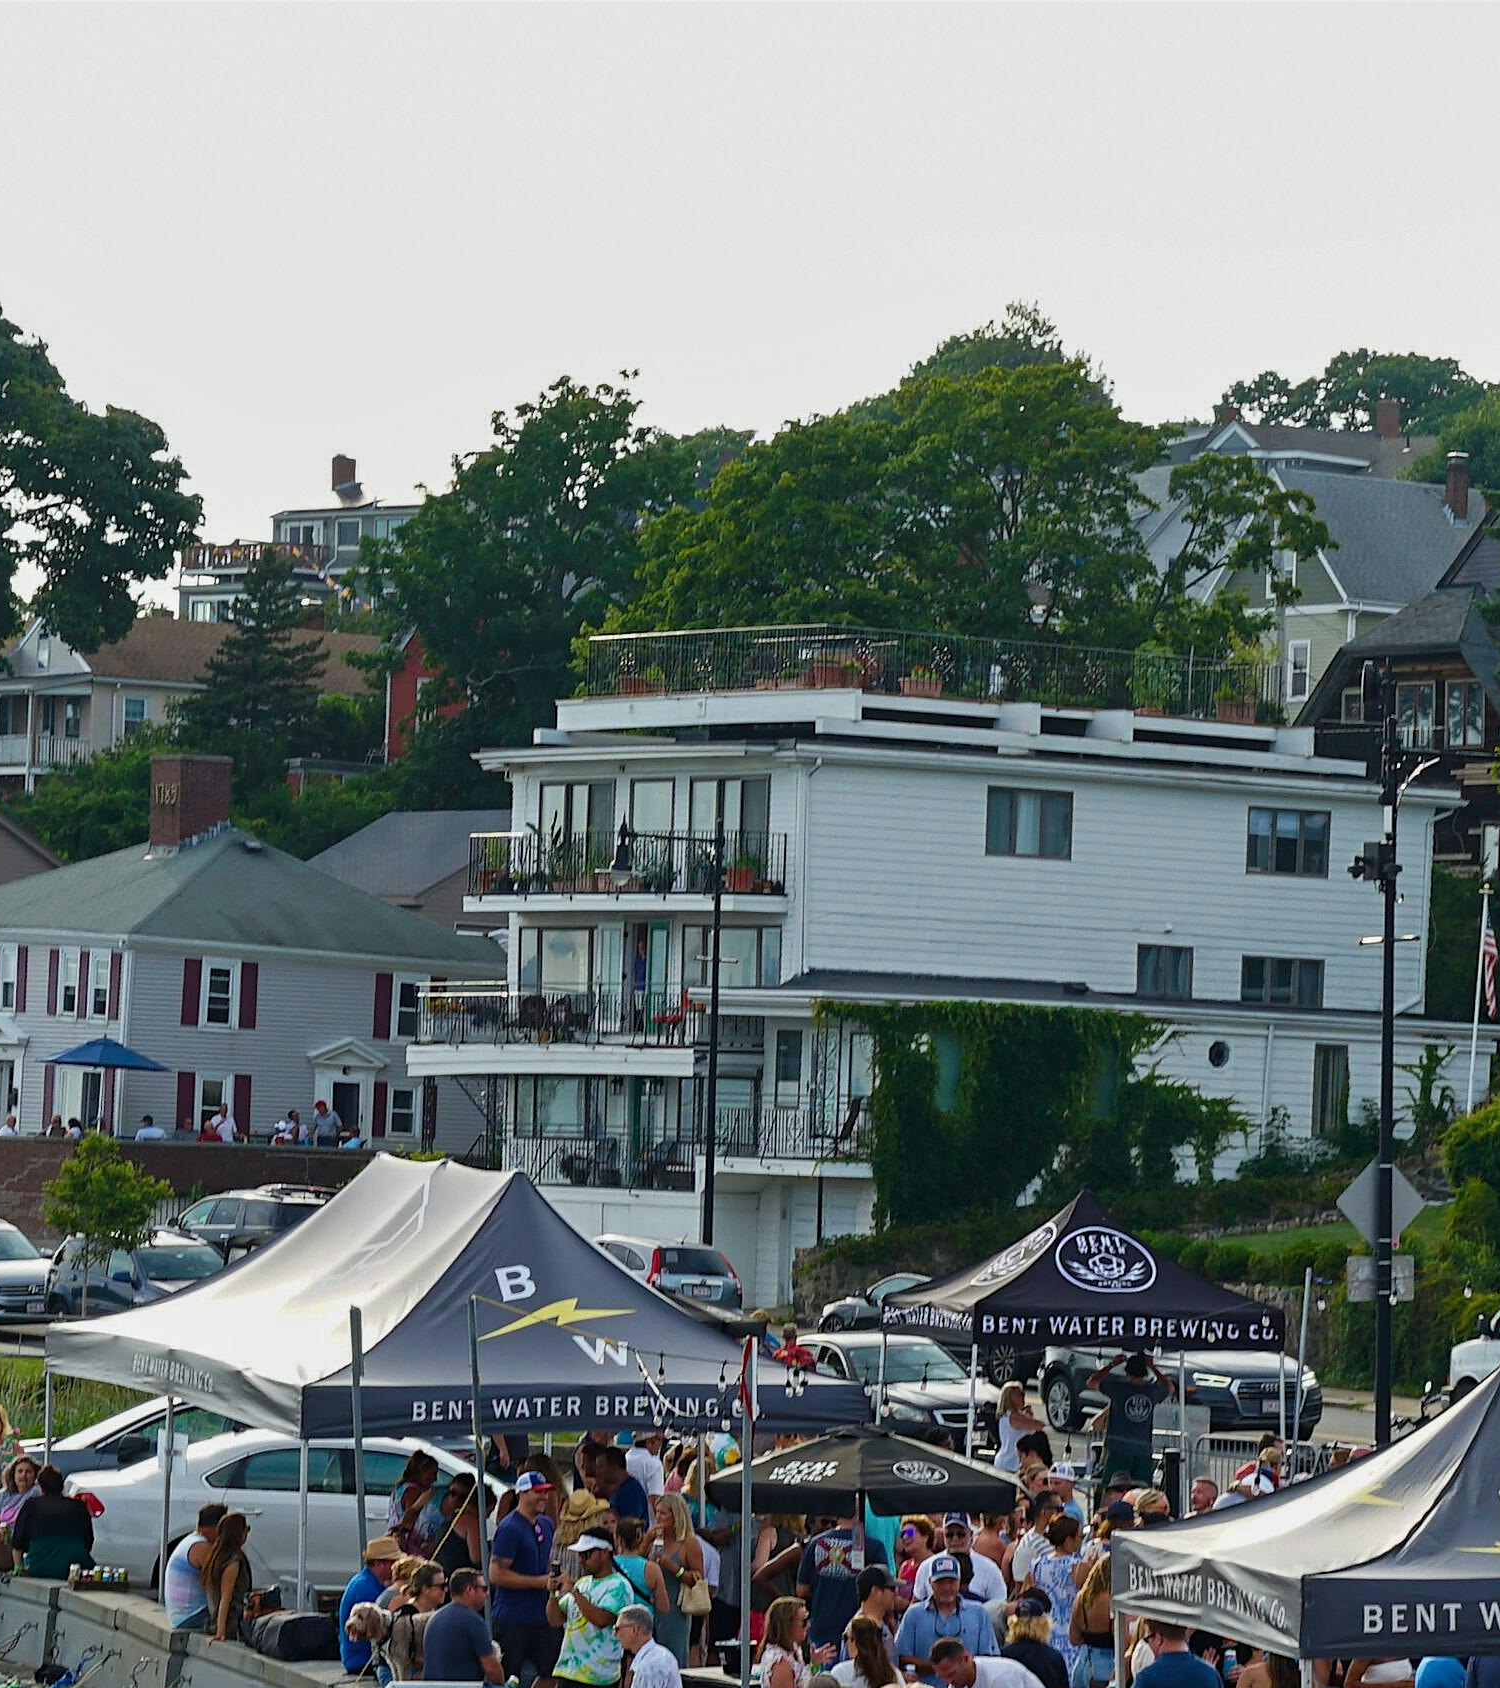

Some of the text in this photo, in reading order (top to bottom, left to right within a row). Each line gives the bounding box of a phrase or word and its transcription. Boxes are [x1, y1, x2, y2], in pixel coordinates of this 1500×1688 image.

[495, 1264, 536, 1303] B
[982, 1315, 1040, 1336] BENT
[1050, 1315, 1125, 1337] WATER
[1134, 1316, 1240, 1341] BREWING
[572, 1335, 628, 1366] W
[492, 1397, 582, 1419] WATER
[595, 1395, 718, 1420] BREWING
[1129, 1562, 1158, 1597] BENT
[1161, 1573, 1202, 1603] WATER
[1362, 1603, 1463, 1634] BENT
